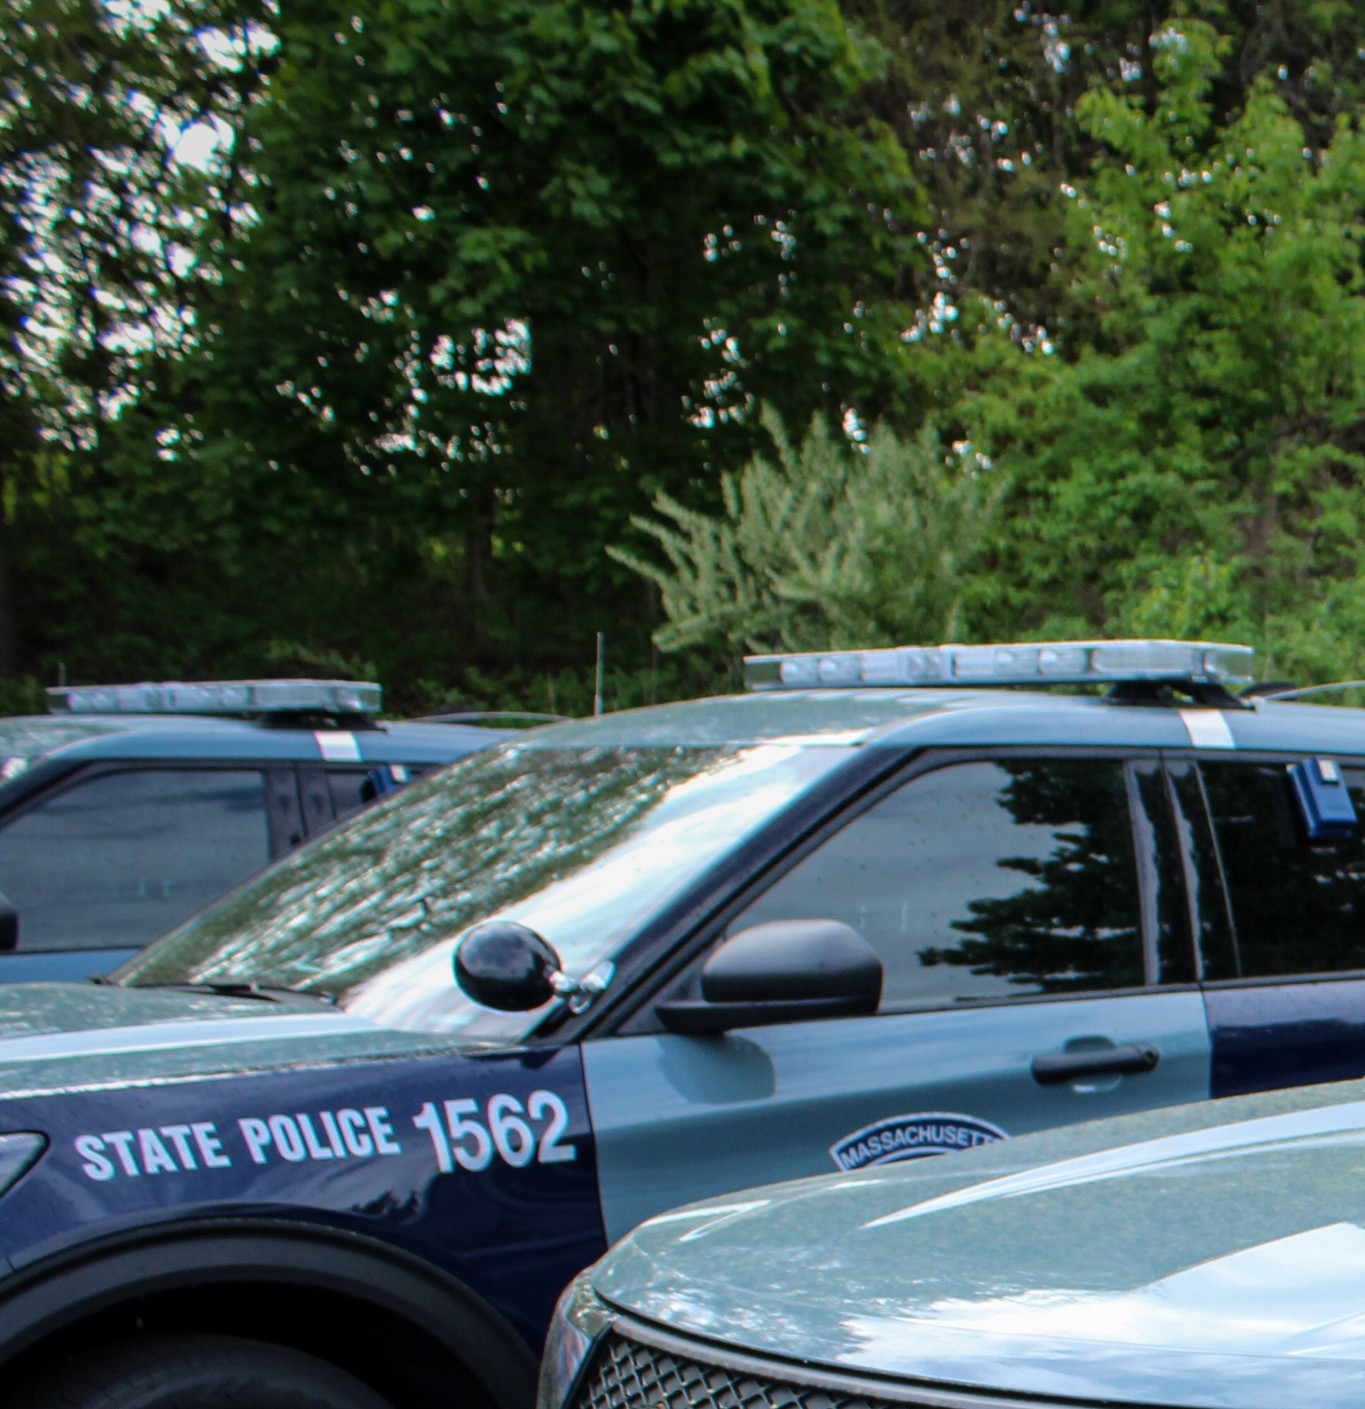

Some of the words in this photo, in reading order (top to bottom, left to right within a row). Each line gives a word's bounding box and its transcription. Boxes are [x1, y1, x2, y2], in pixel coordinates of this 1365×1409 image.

[75, 1122, 232, 1182] STATE
[238, 1107, 401, 1164] POLICE
[412, 1089, 576, 1173] 1562
